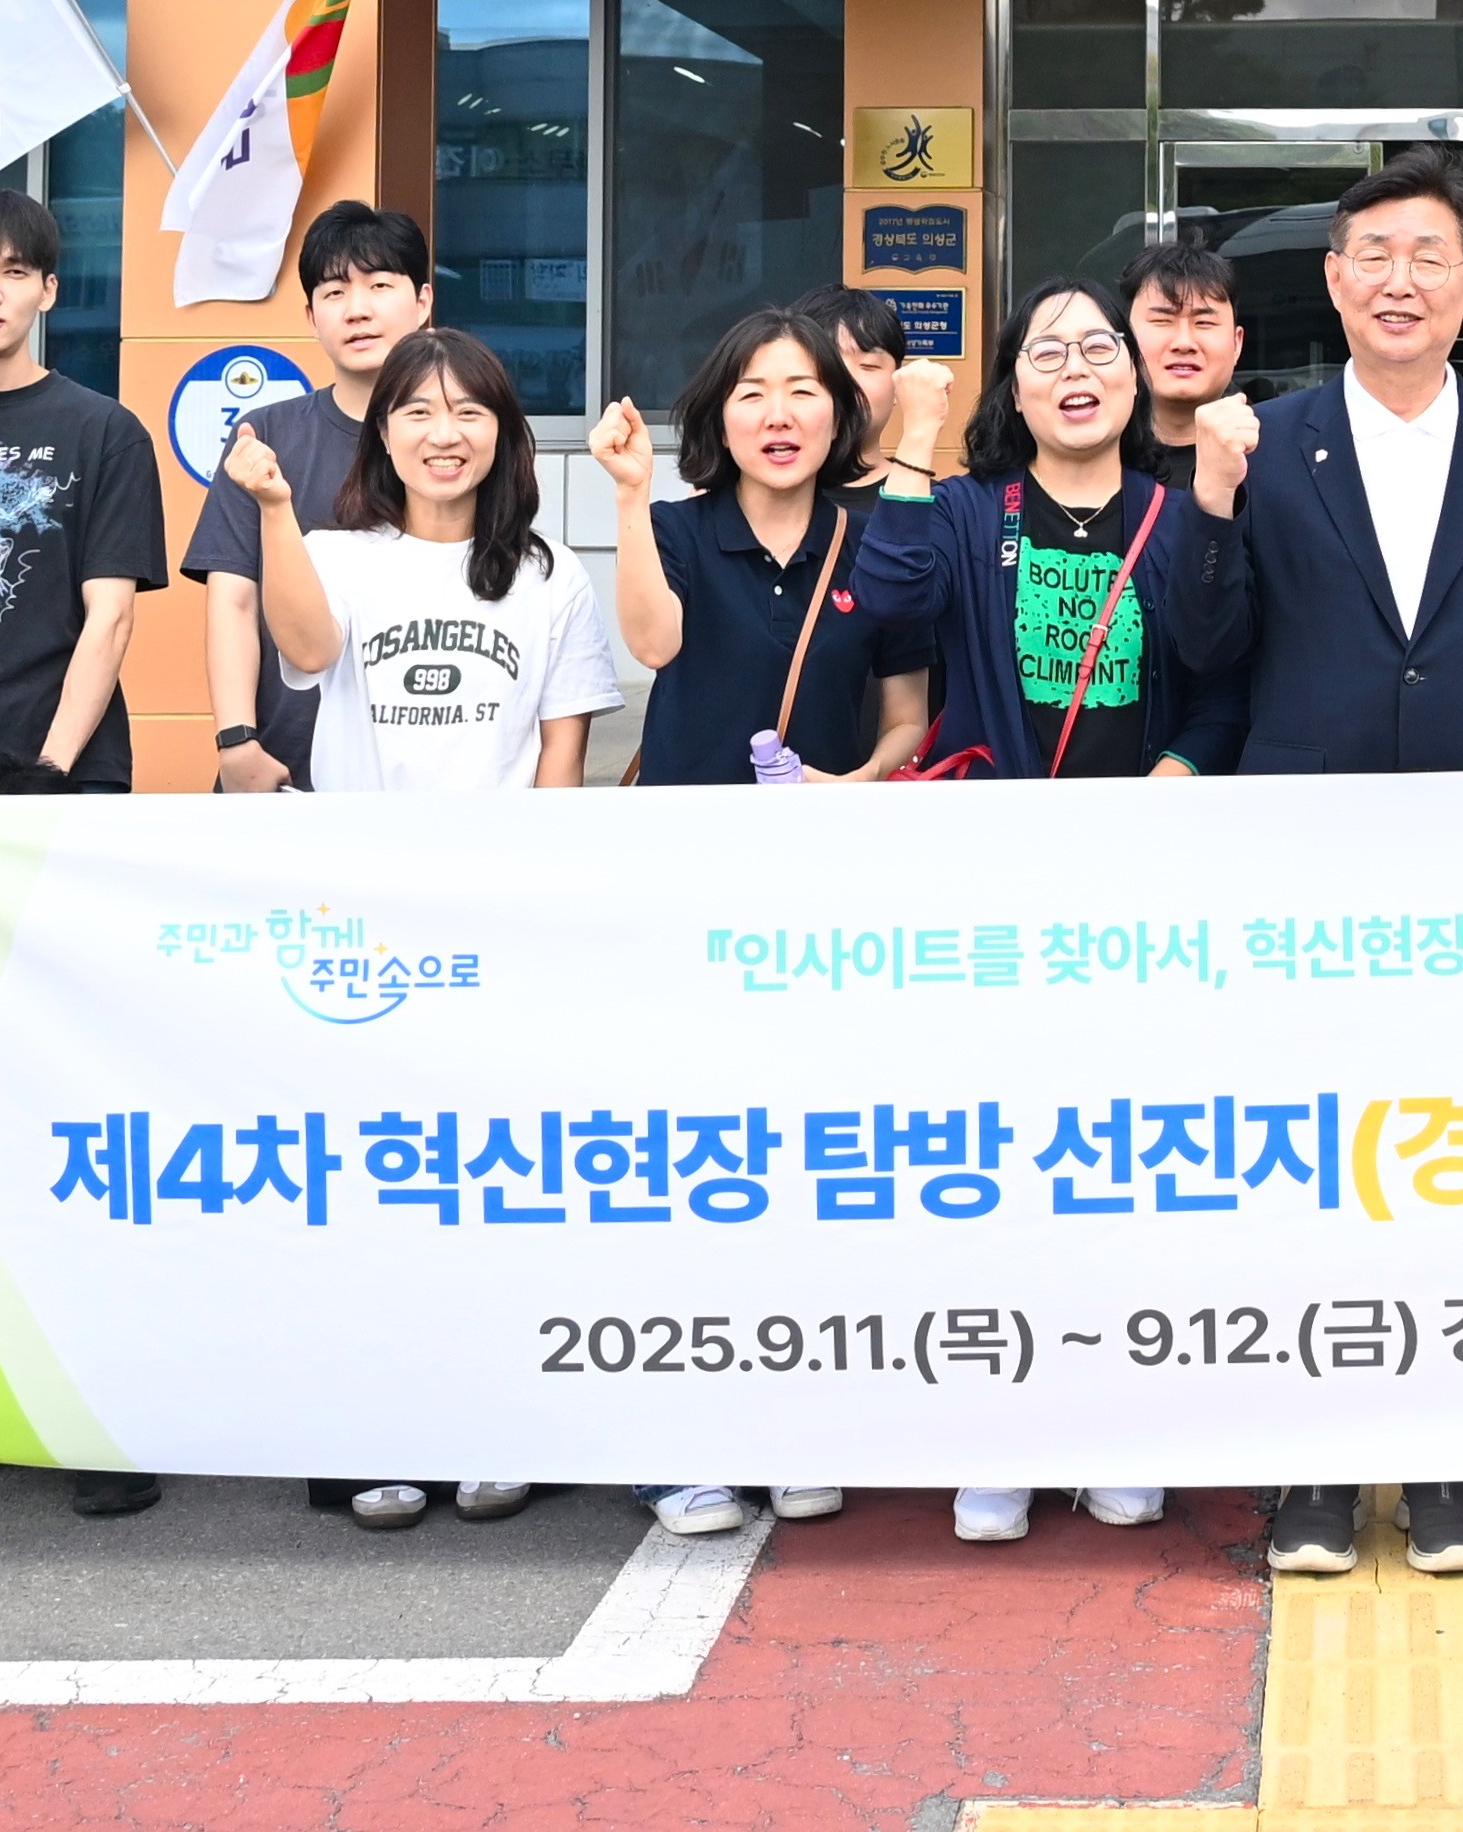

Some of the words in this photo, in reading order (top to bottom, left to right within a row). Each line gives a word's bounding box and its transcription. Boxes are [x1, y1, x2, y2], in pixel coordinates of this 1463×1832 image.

[872, 232, 918, 247] 경상북도
[922, 232, 957, 247] 의성군
[27, 446, 55, 462] ME
[1001, 481, 1021, 567] BENETTON
[1058, 596, 1096, 620] NO
[413, 668, 451, 691] 998
[476, 702, 500, 722] ST
[156, 923, 259, 964] 주민과
[265, 909, 364, 969] 함께
[707, 924, 1025, 992] 『인사이트를
[1040, 919, 1228, 990] 찾아서,
[49, 1110, 343, 1227] 제4차
[358, 1106, 784, 1227] 혁신현장
[803, 1100, 1015, 1222] 탐방
[539, 1308, 1035, 1384] 2025.9.11.(목)
[1125, 1299, 1418, 1378] 9.12.(금)
